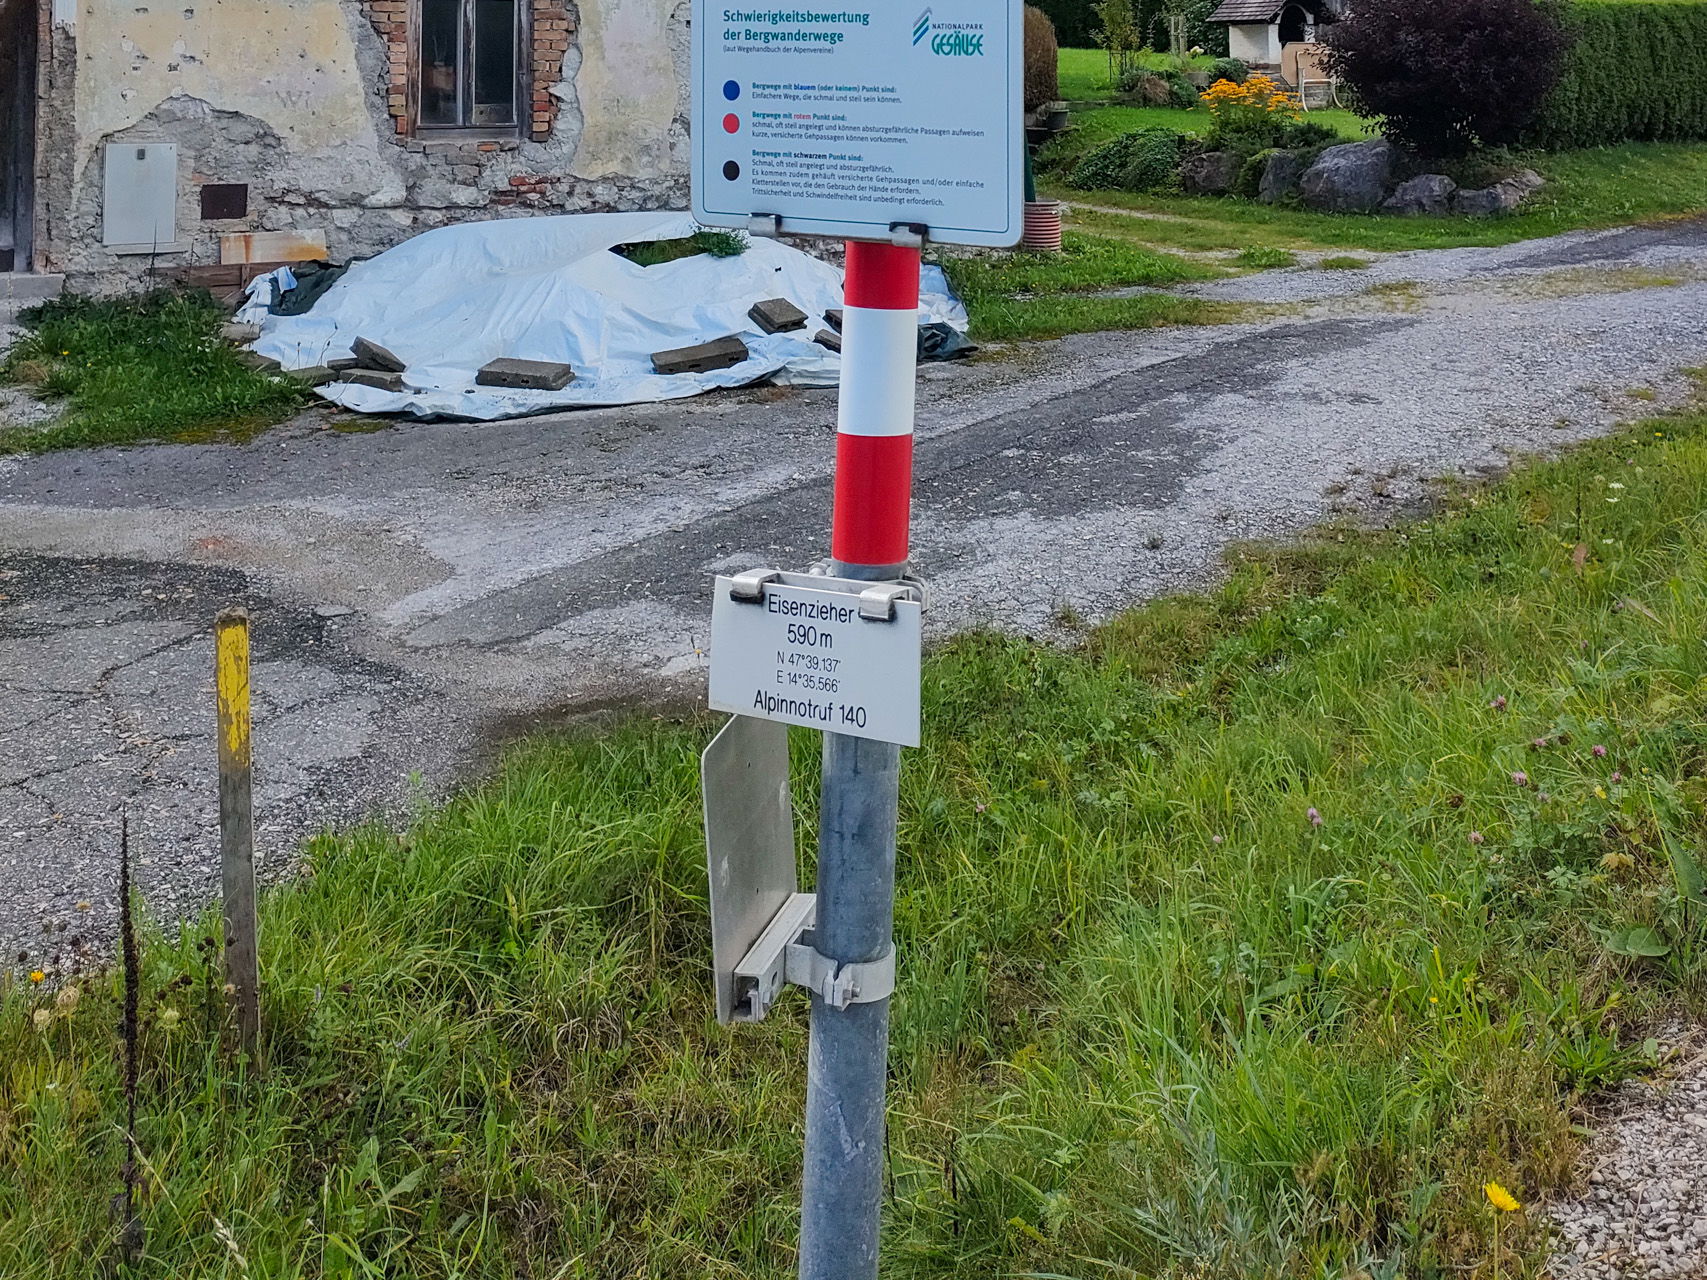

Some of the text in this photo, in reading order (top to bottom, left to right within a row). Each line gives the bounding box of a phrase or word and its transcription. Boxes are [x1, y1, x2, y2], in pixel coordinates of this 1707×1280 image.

[723, 9, 870, 26] Schwierigkeitsbewertung
[723, 28, 844, 44] der Bergwanderwege
[723, 45, 736, 53] (laut
[737, 46, 781, 54] Wegehandbuch
[793, 47, 834, 55] Alpenvereine)
[931, 31, 984, 57] GESÄUSE
[752, 82, 781, 91] Bergwege
[817, 84, 834, 92] (oder
[835, 84, 860, 93] keinem)
[752, 92, 782, 100] Einfachere
[783, 93, 801, 101] Wege,
[813, 93, 834, 101] schmal
[848, 94, 861, 102] steil
[752, 111, 781, 120] Bergwege
[752, 120, 774, 129] schmal,
[784, 121, 797, 129] steil
[798, 122, 824, 131] angelegt
[825, 123, 837, 131] und
[838, 123, 861, 132] können
[920, 127, 950, 137] Passagen
[752, 130, 908, 144] kurze, versicherte Gehpassagen können vorkommen.
[752, 149, 781, 159] Bergwege
[782, 150, 792, 158] mit
[793, 151, 828, 159] schwarzem
[828, 152, 847, 160] Punkt
[752, 159, 775, 168] Schmal,
[785, 160, 798, 168] steil
[799, 161, 825, 170] angelegt
[752, 168, 984, 188] Es kommen zudem gehäuft versicherte Gehpassagen und/oder einfache
[791, 181, 802, 189] vor,
[803, 181, 813, 189] die
[814, 181, 825, 189] den
[826, 182, 856, 191] Gebrauch
[856, 184, 867, 192] der
[868, 184, 889, 193] Hände
[890, 186, 921, 195] erfordern.
[792, 190, 804, 198] und
[858, 194, 872, 202] sind
[873, 195, 905, 205] unbedingt
[906, 198, 945, 207] erforderlich.
[768, 593, 854, 623] Eisenzieher
[787, 623, 833, 649] 590 m
[777, 650, 785, 664] N
[776, 669, 784, 684] E
[754, 689, 867, 728] Alpinnotruf 140
